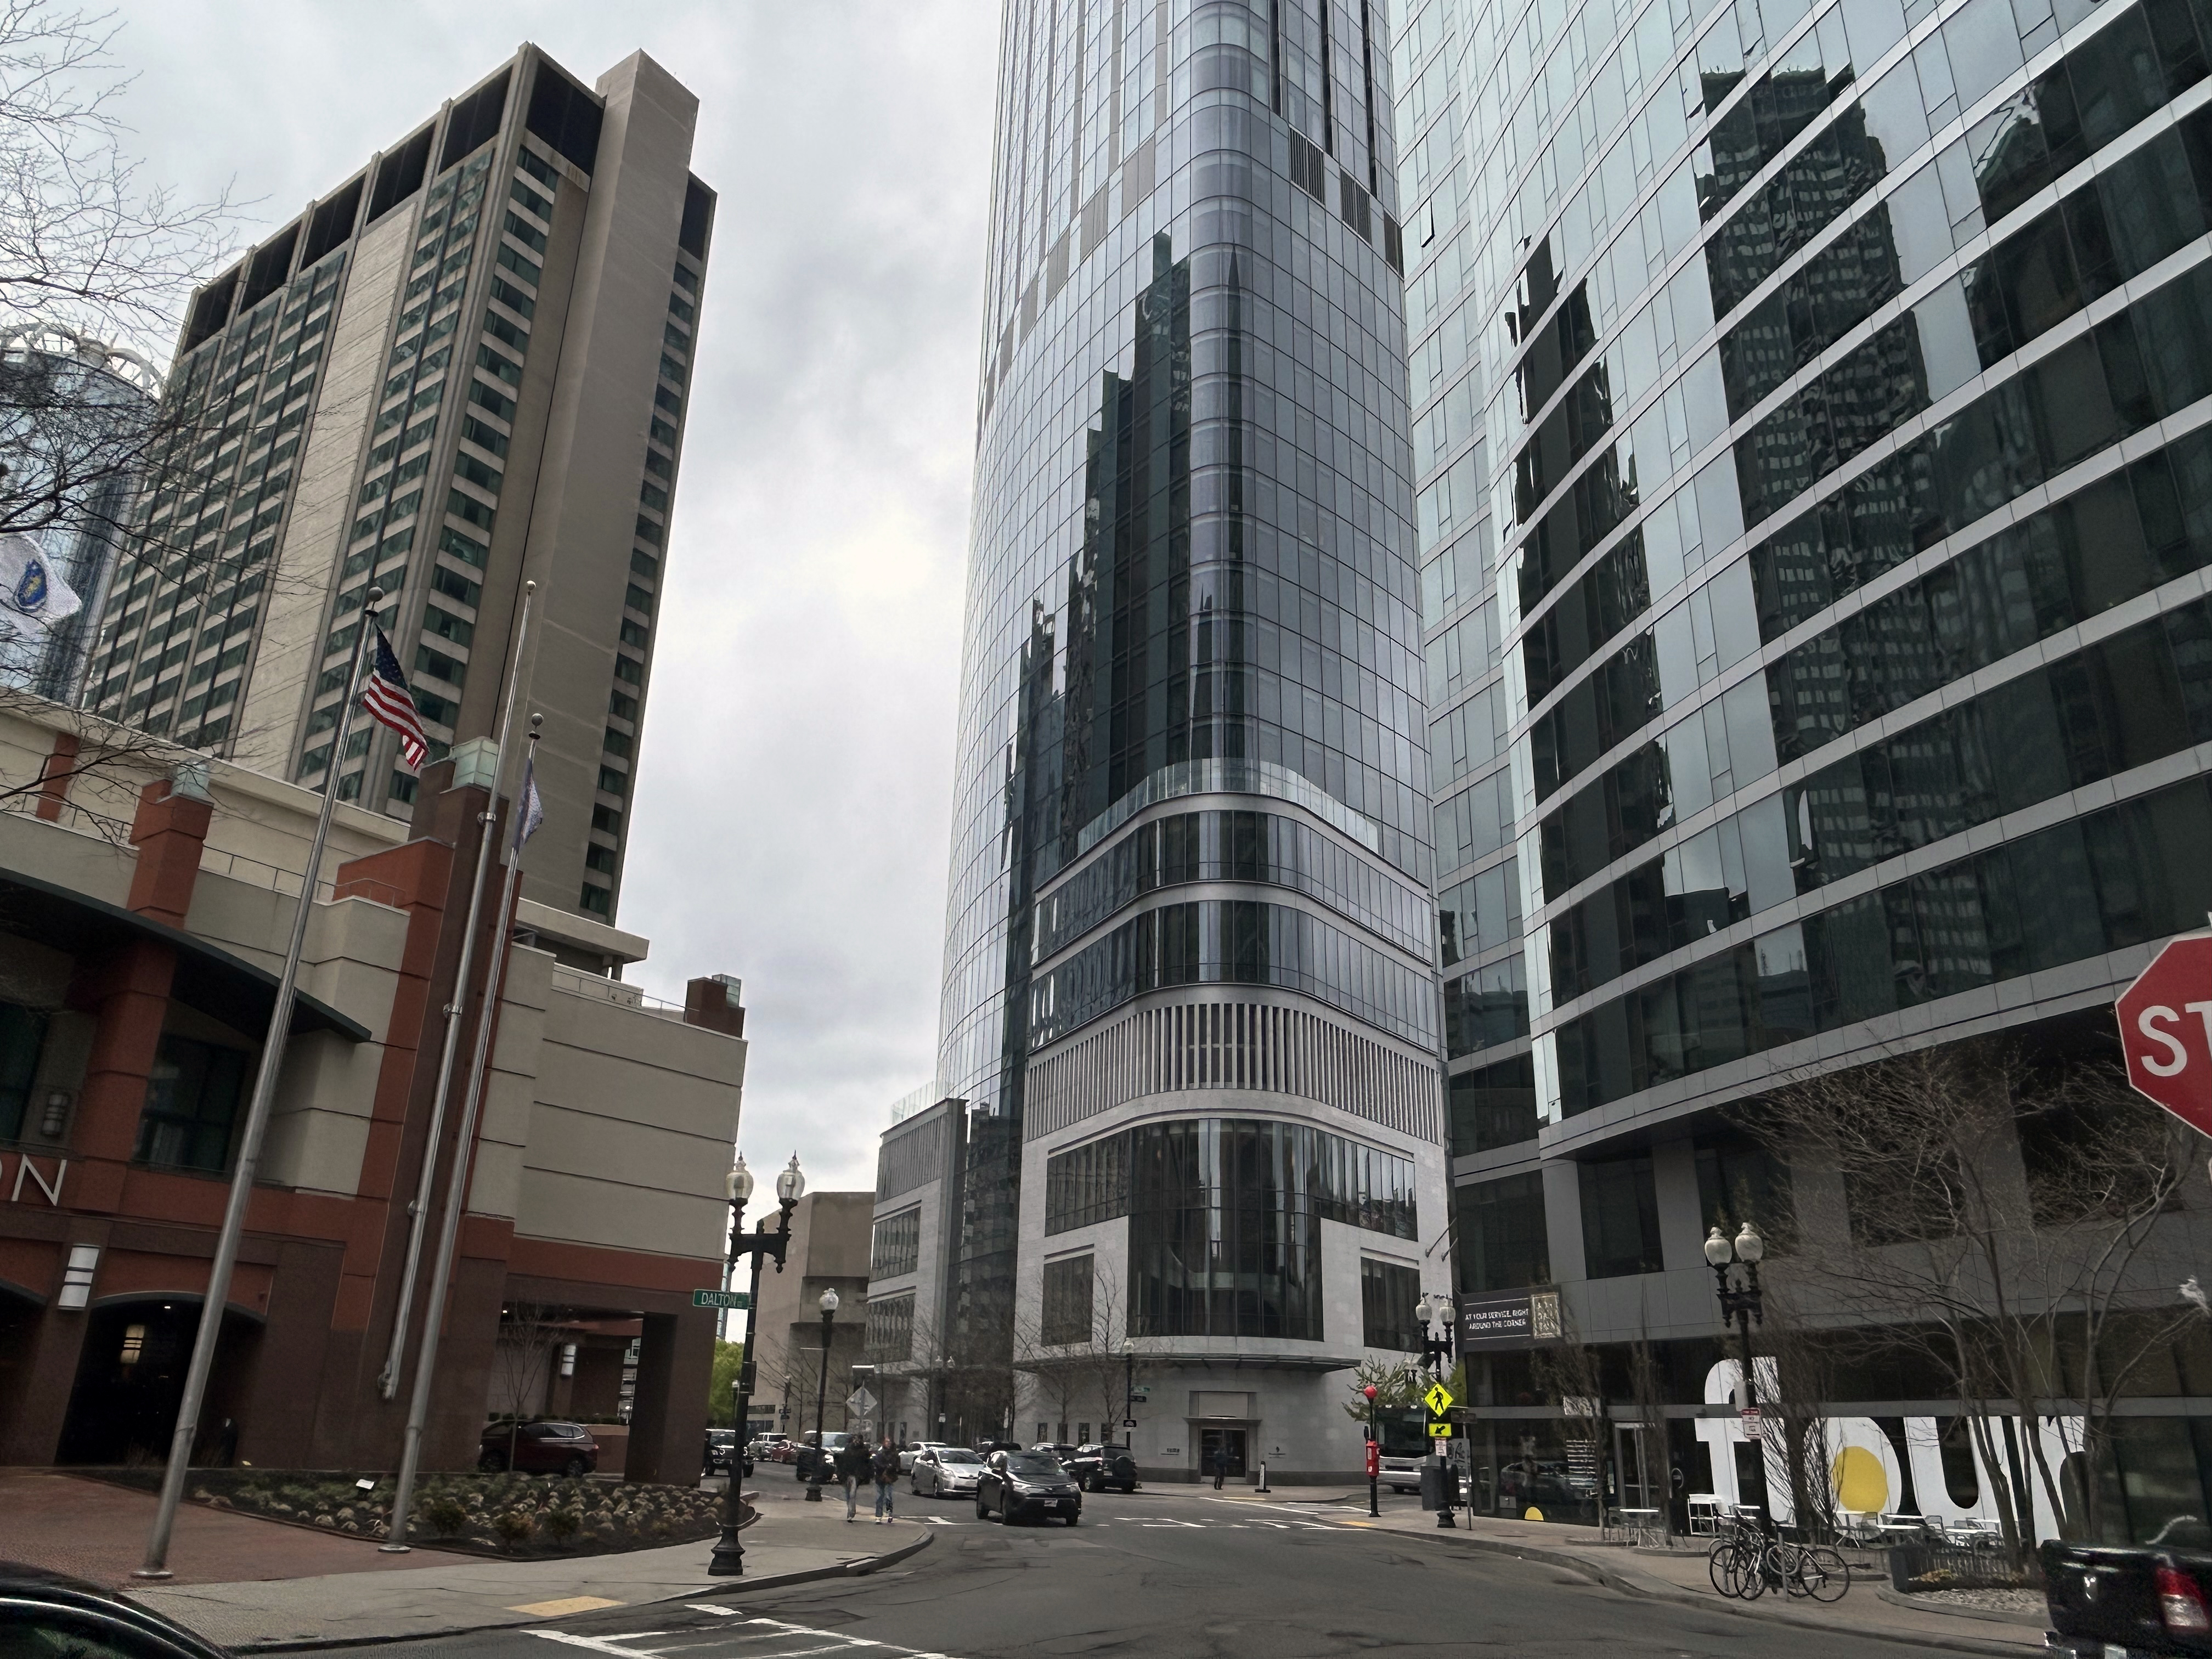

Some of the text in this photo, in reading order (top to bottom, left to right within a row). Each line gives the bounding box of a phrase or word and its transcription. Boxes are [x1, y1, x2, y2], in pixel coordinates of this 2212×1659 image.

[0, 1153, 67, 1206] N
[701, 1292, 737, 1307] DALTON
[1694, 1357, 2085, 1548] flour
